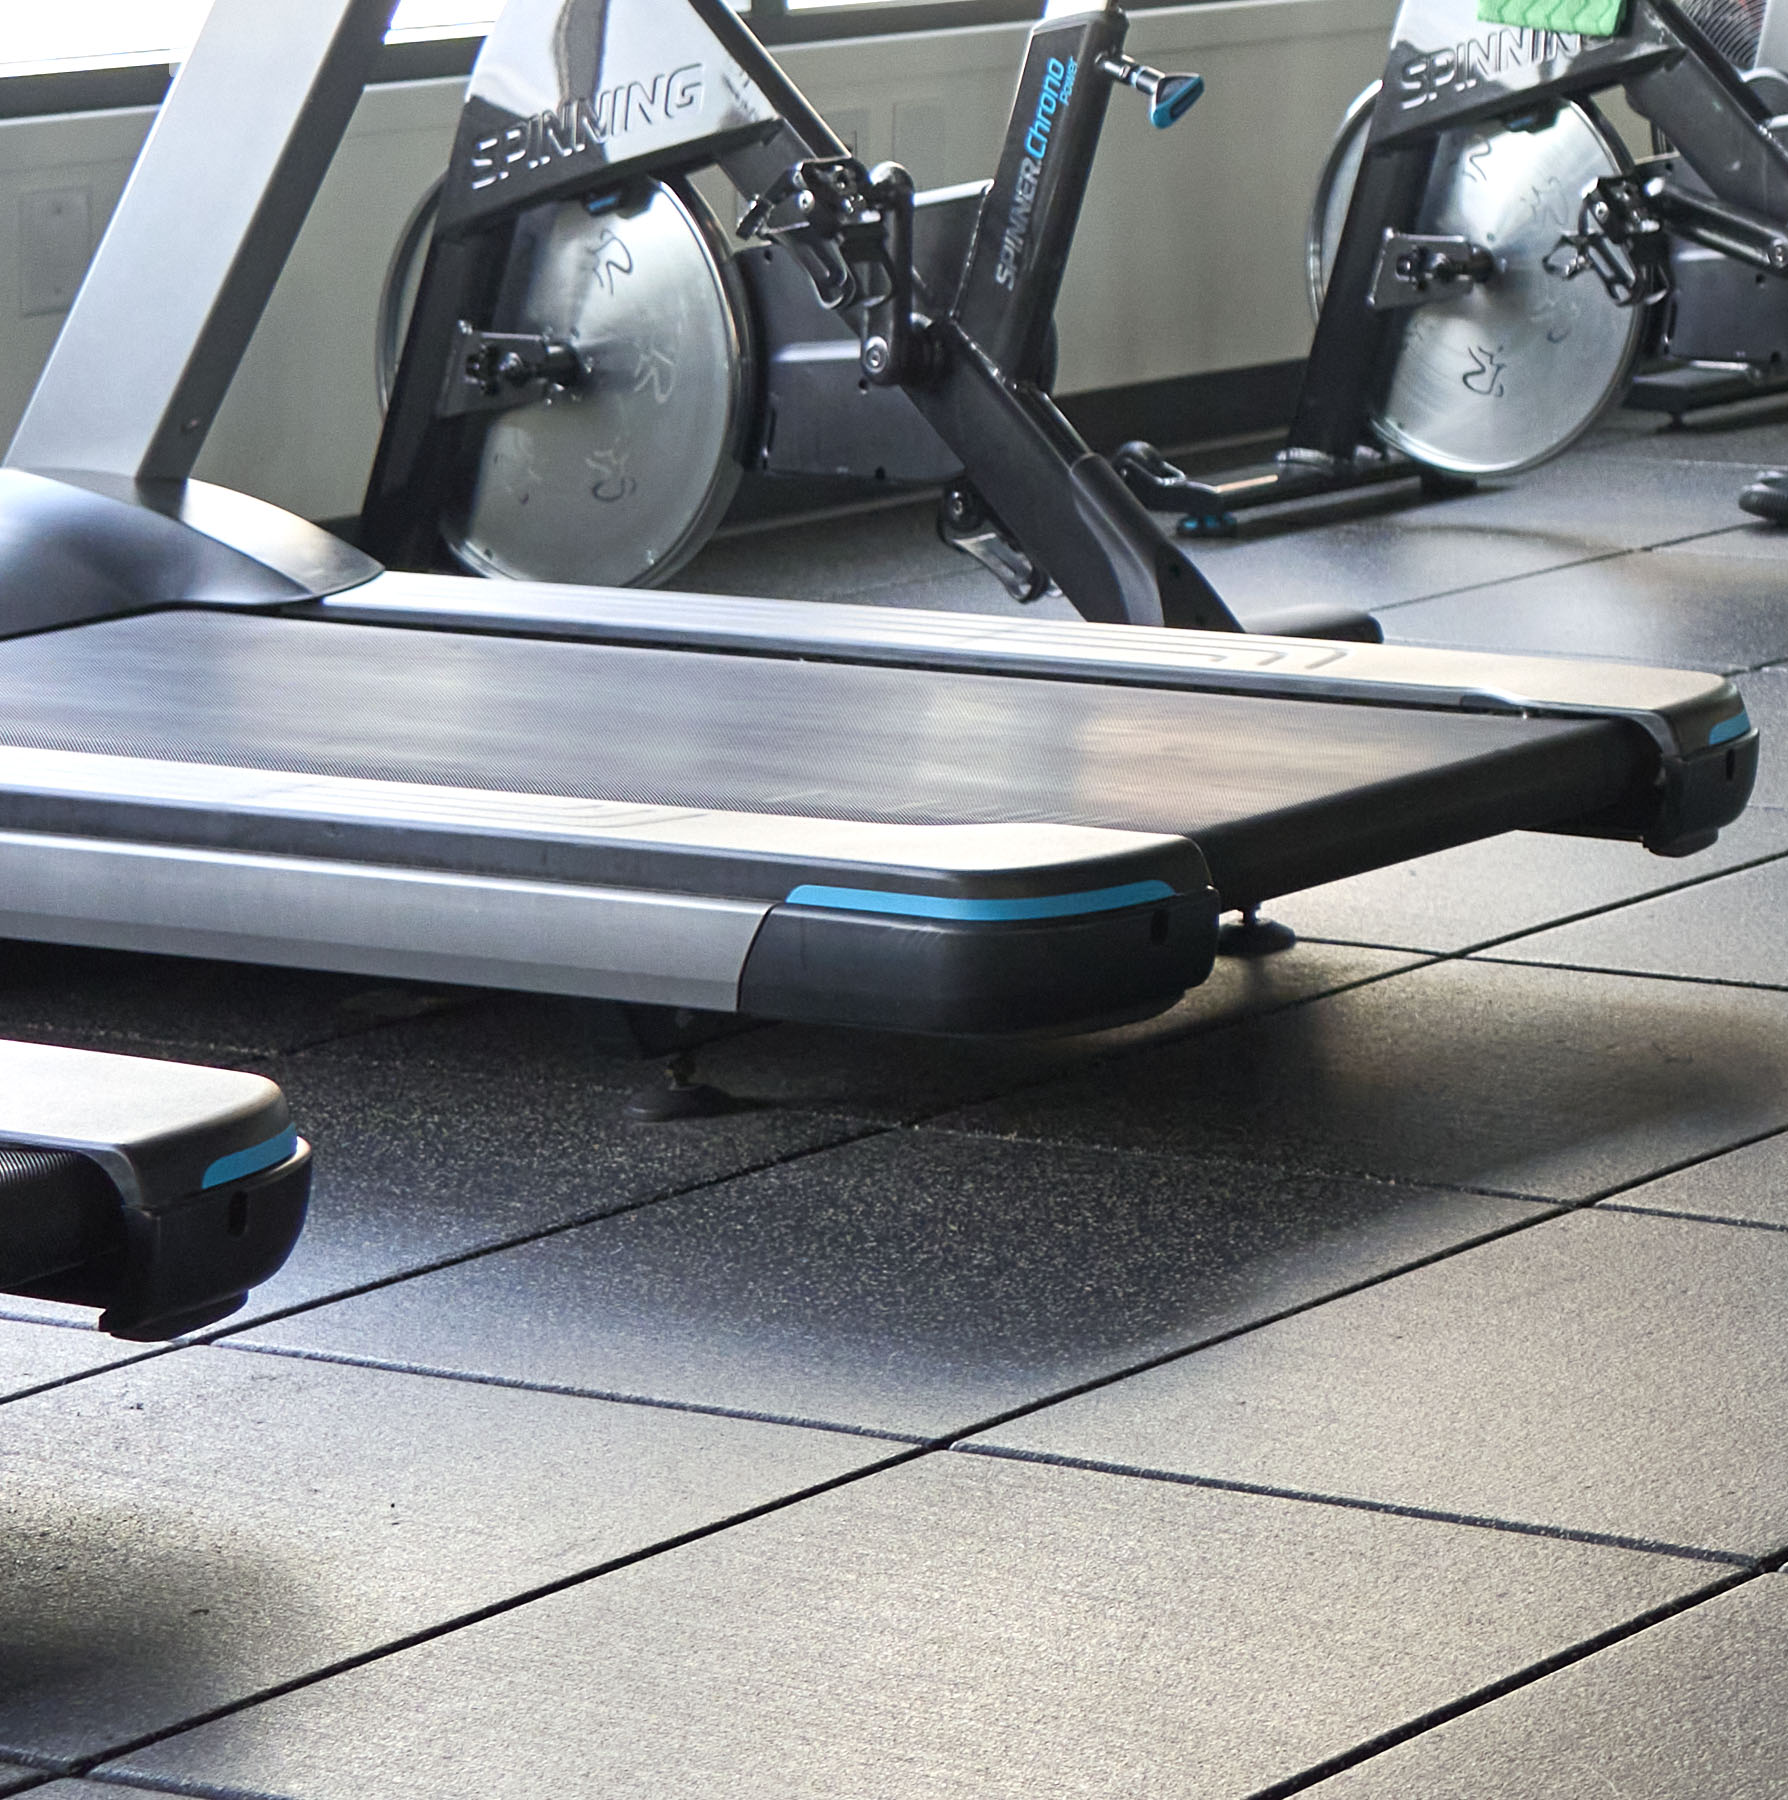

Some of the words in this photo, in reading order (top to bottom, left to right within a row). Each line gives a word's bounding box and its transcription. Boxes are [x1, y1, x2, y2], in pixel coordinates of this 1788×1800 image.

[1024, 56, 1066, 161] Chrono
[1058, 54, 1079, 107] Power
[1400, 25, 1615, 110] SPINNIN
[471, 61, 703, 191] SPINNING
